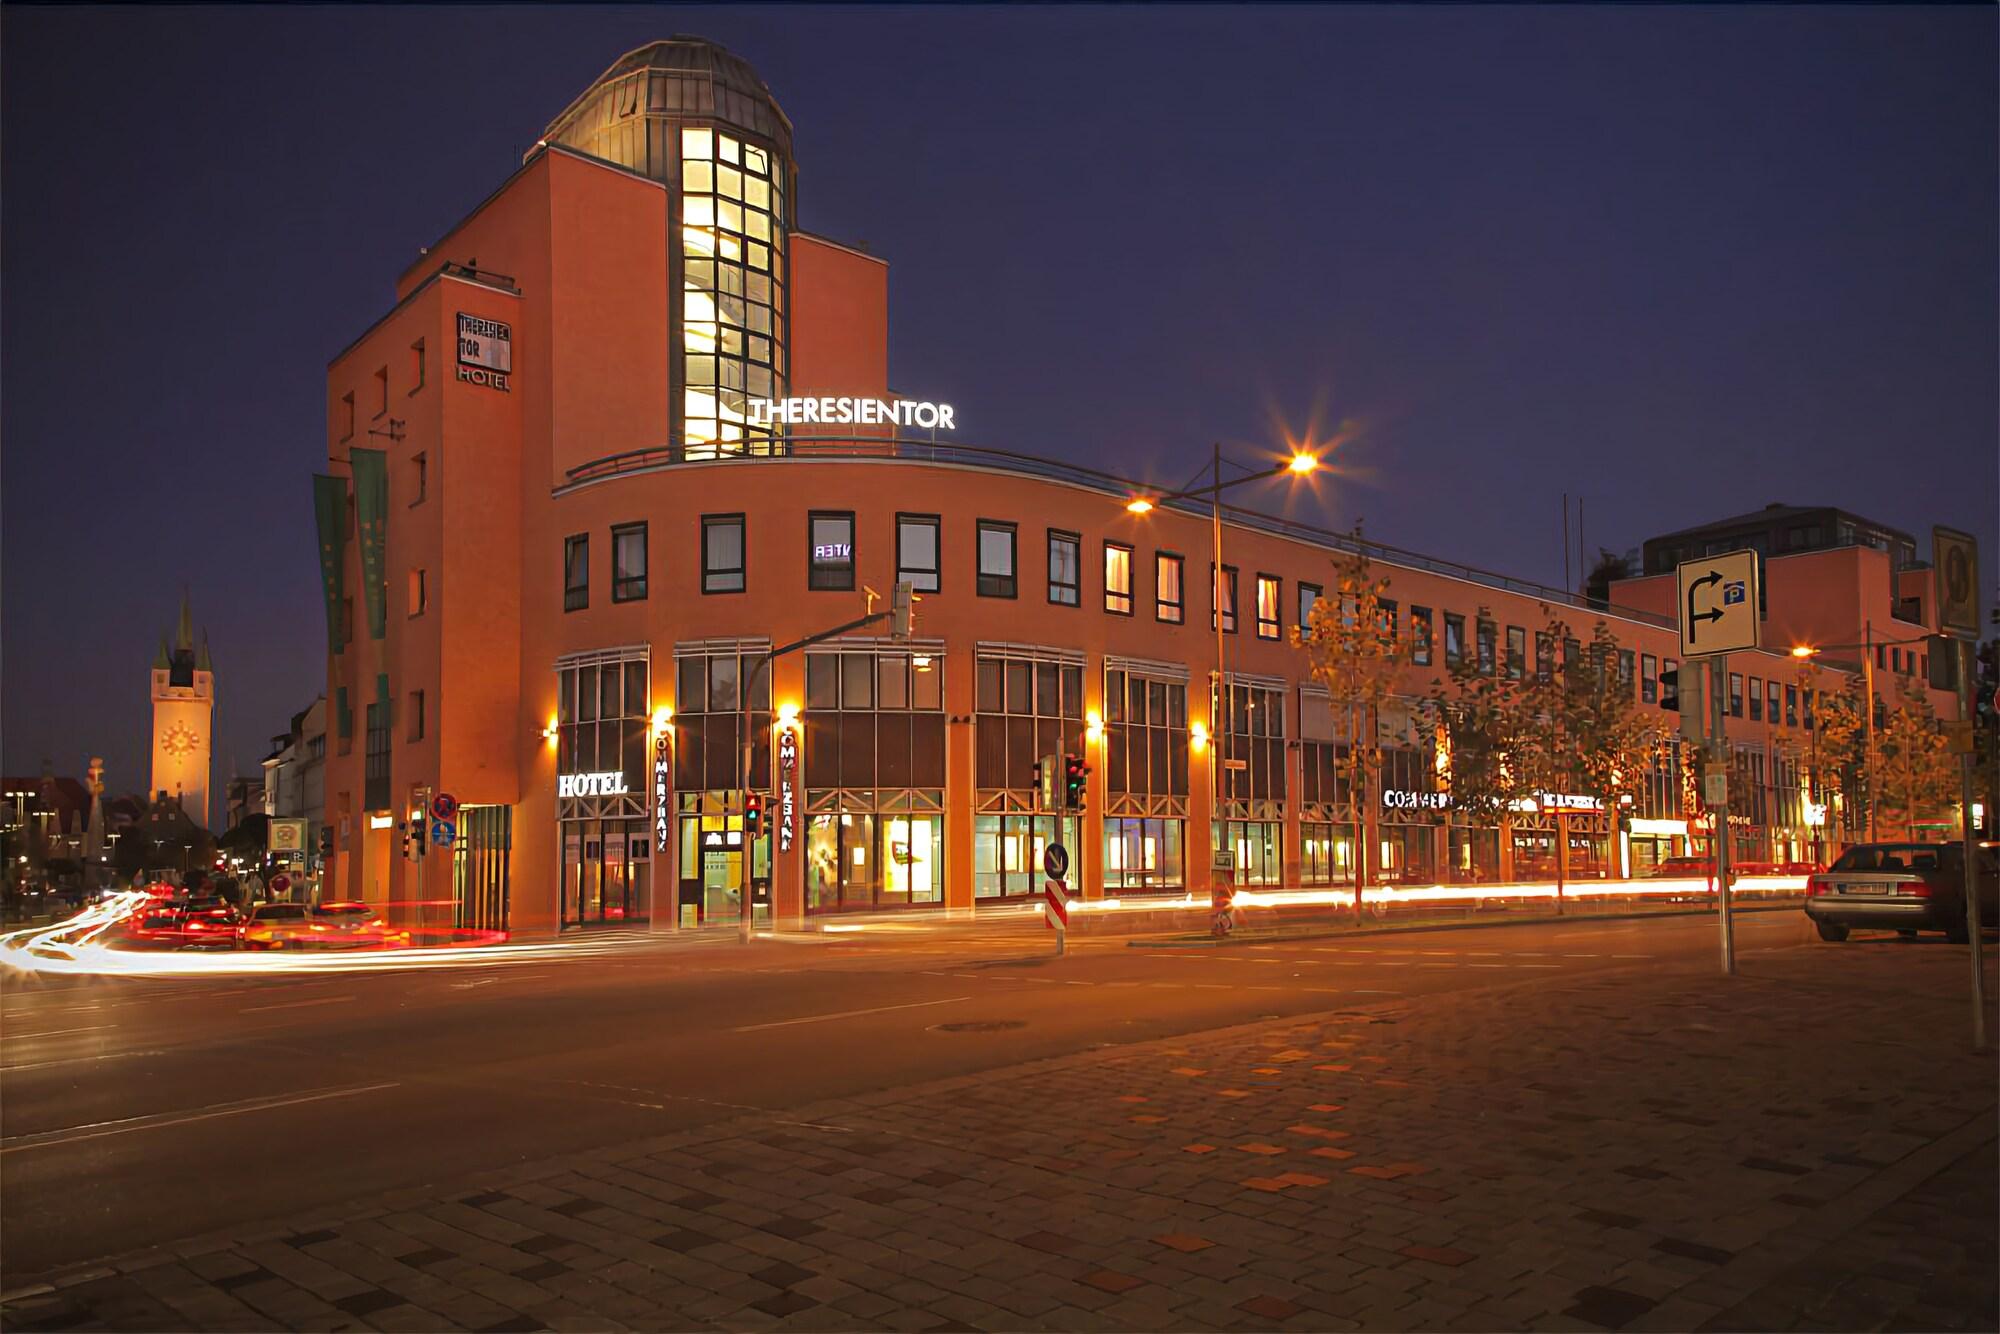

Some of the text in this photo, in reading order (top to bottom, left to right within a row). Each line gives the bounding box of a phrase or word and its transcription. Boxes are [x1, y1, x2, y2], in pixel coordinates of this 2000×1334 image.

[460, 337, 480, 358] TOR
[458, 366, 511, 393] HOTEL
[748, 397, 955, 430] THERESIENTOR
[558, 771, 628, 798] HOTEL
